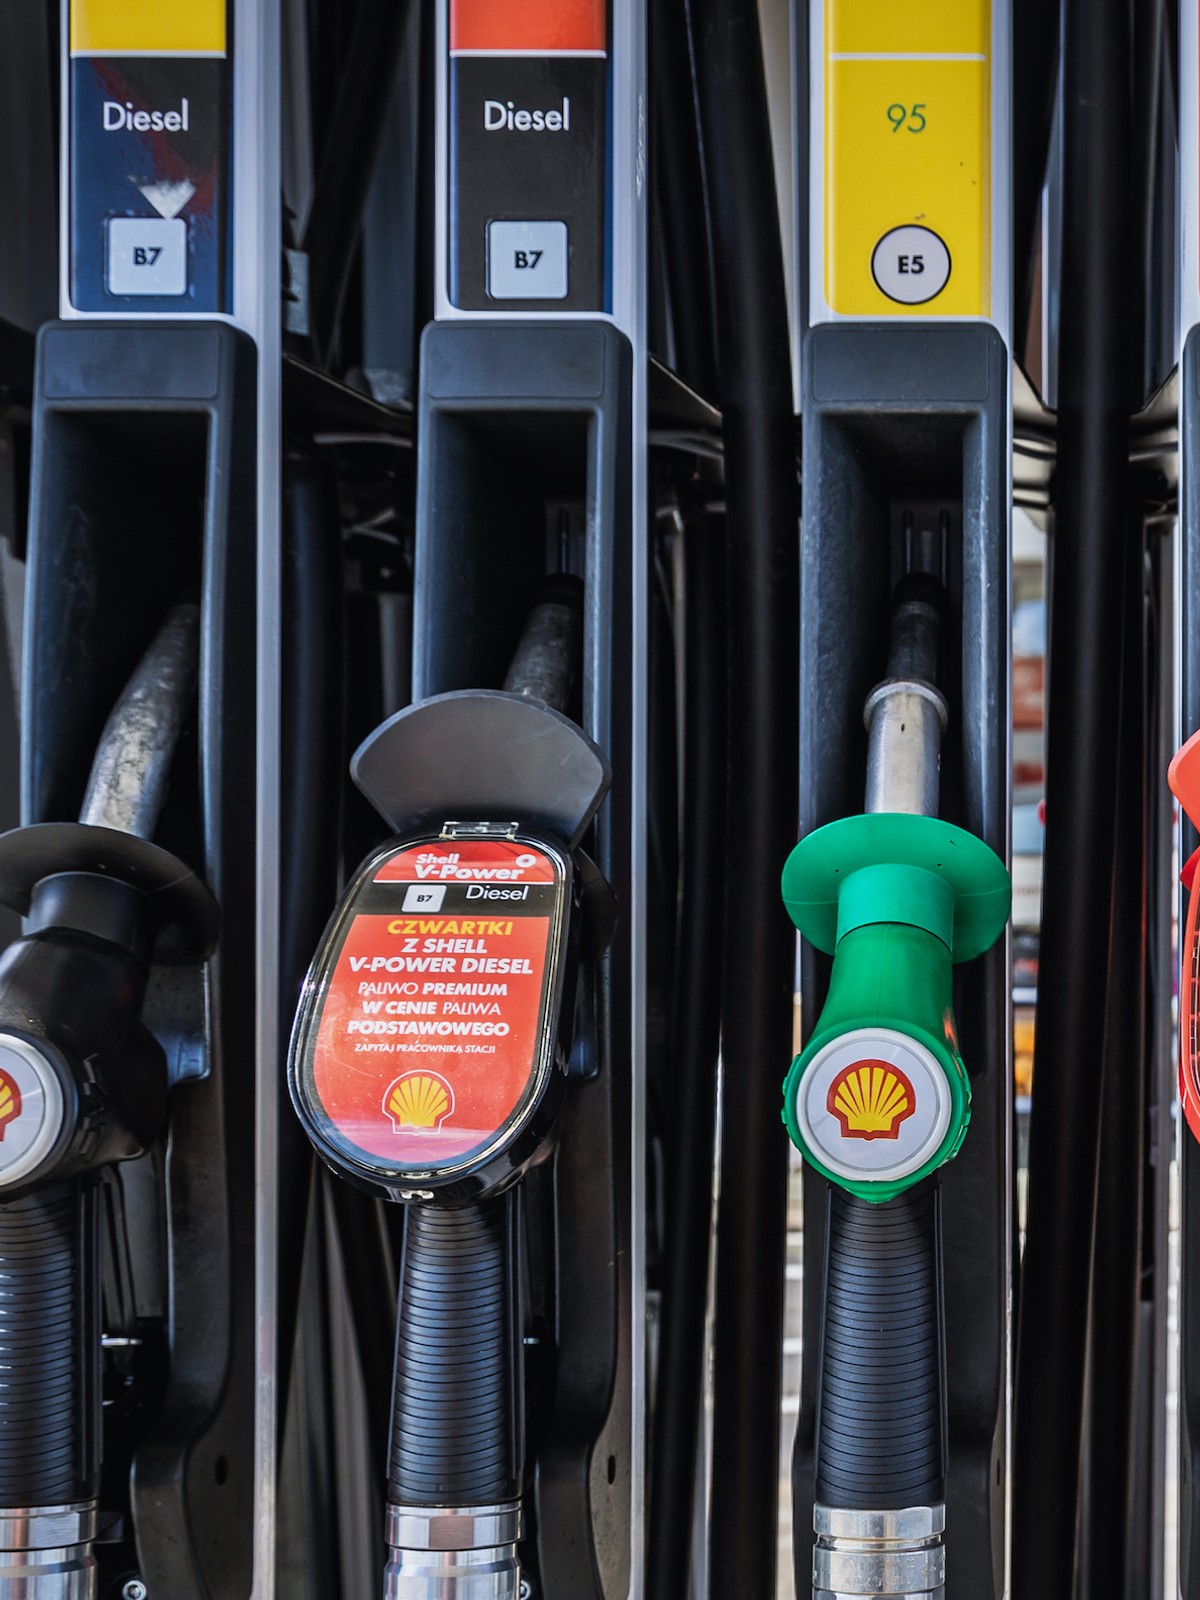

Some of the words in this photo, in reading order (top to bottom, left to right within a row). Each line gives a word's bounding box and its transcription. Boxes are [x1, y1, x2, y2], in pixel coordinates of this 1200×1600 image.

[103, 98, 189, 132] Diesel
[484, 96, 570, 132] Diesel
[886, 103, 927, 133] 95
[132, 246, 163, 267] B7
[514, 250, 544, 270] B7
[897, 255, 925, 274] E5
[415, 853, 459, 865] Shell
[414, 863, 524, 880] V-Power
[417, 894, 433, 903] B7
[465, 884, 529, 901] Diesel
[387, 920, 513, 936] CZWARTKI
[401, 938, 418, 953] Z
[422, 938, 488, 954] SHELL
[349, 956, 456, 974] V-POWER
[460, 957, 533, 975] DIESEL
[358, 982, 419, 995] PALIWO
[422, 983, 507, 996] PREMIUM
[362, 1001, 384, 1014] W
[385, 1001, 437, 1015] CENIE
[442, 1002, 501, 1016] PALIWA
[347, 1021, 510, 1036] PODSTAWOWEGO
[354, 1043, 395, 1053] ZAPYTAJ
[464, 1044, 496, 1054] STACJI
